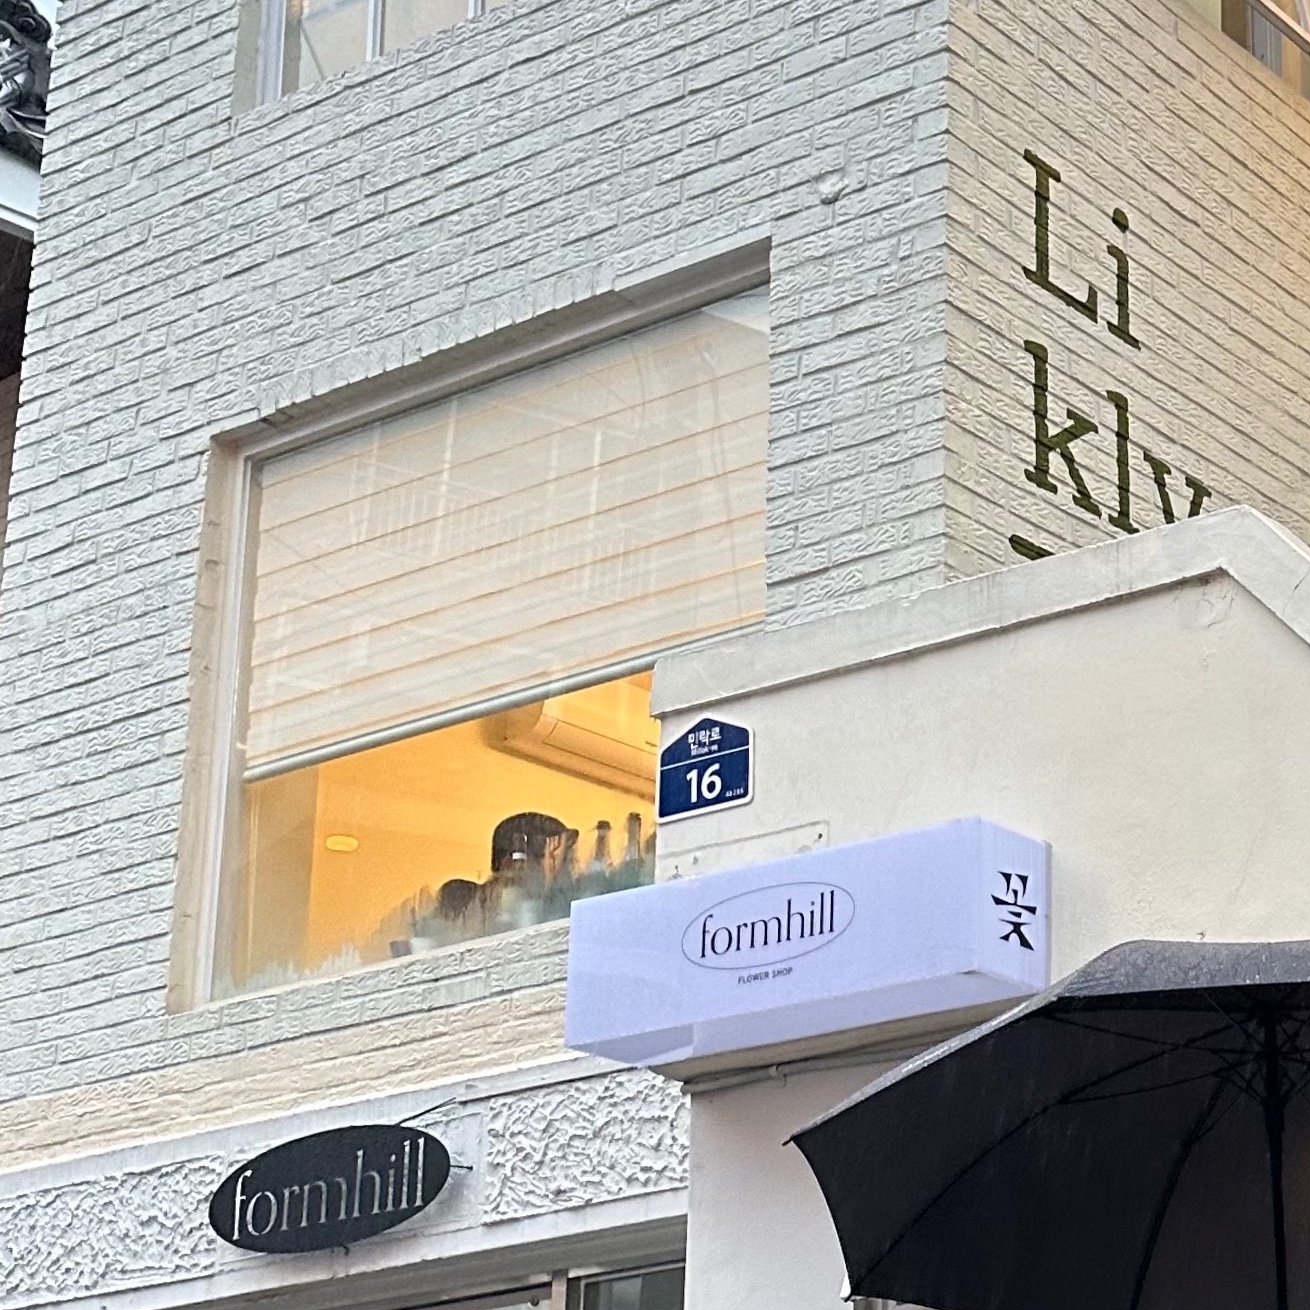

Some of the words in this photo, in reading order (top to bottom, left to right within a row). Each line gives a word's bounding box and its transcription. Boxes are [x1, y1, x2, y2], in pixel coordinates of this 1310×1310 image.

[1023, 148, 1141, 351] Li
[688, 727, 722, 749] 민락로
[686, 763, 722, 803] 16
[700, 889, 836, 959] formhill
[990, 870, 1038, 952] 꽃
[737, 971, 770, 984] FLOWER
[772, 967, 793, 979] SHOP
[231, 1136, 425, 1242] formhill
